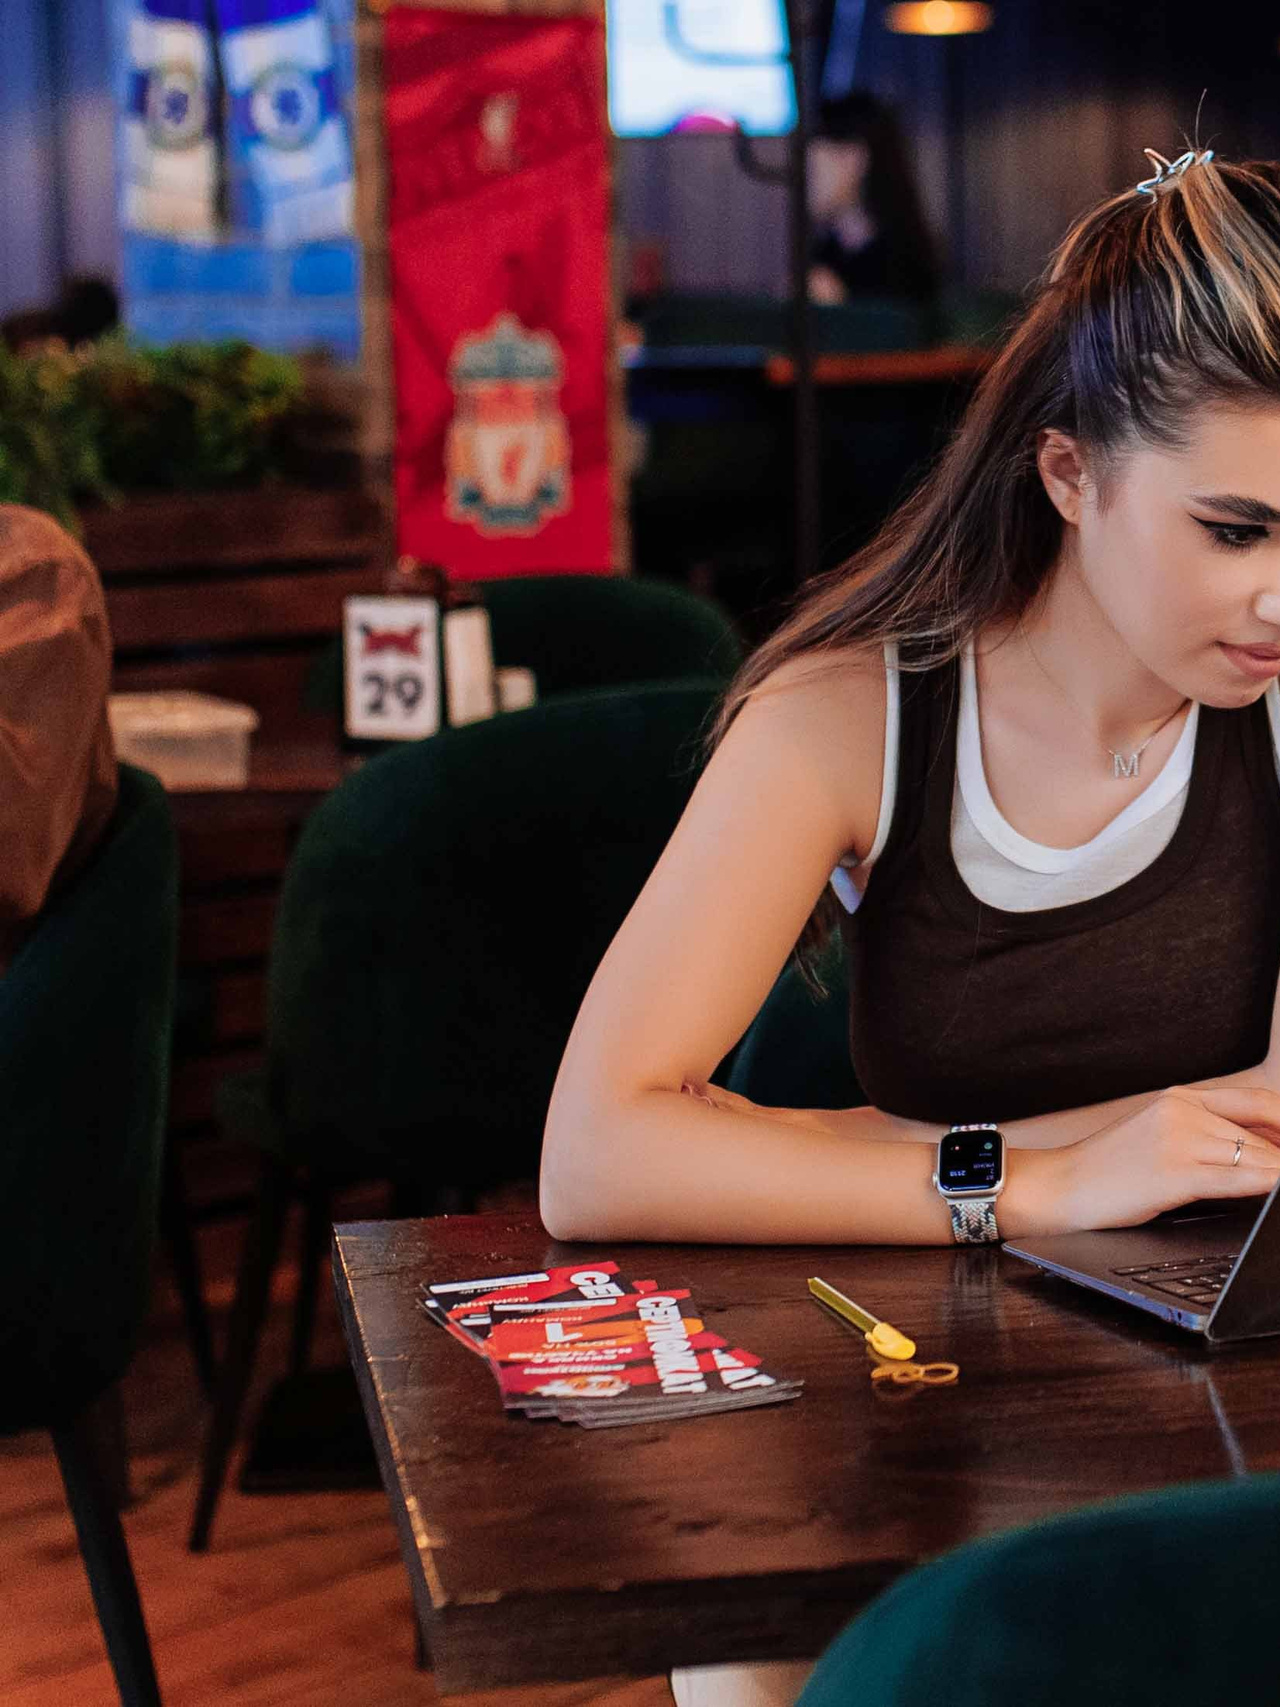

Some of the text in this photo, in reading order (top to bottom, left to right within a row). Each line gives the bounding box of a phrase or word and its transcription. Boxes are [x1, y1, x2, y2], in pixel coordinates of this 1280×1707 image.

[362, 672, 423, 715] 29
[1113, 753, 1139, 777] M
[635, 1296, 708, 1394] СЕРТИФИКАТ
